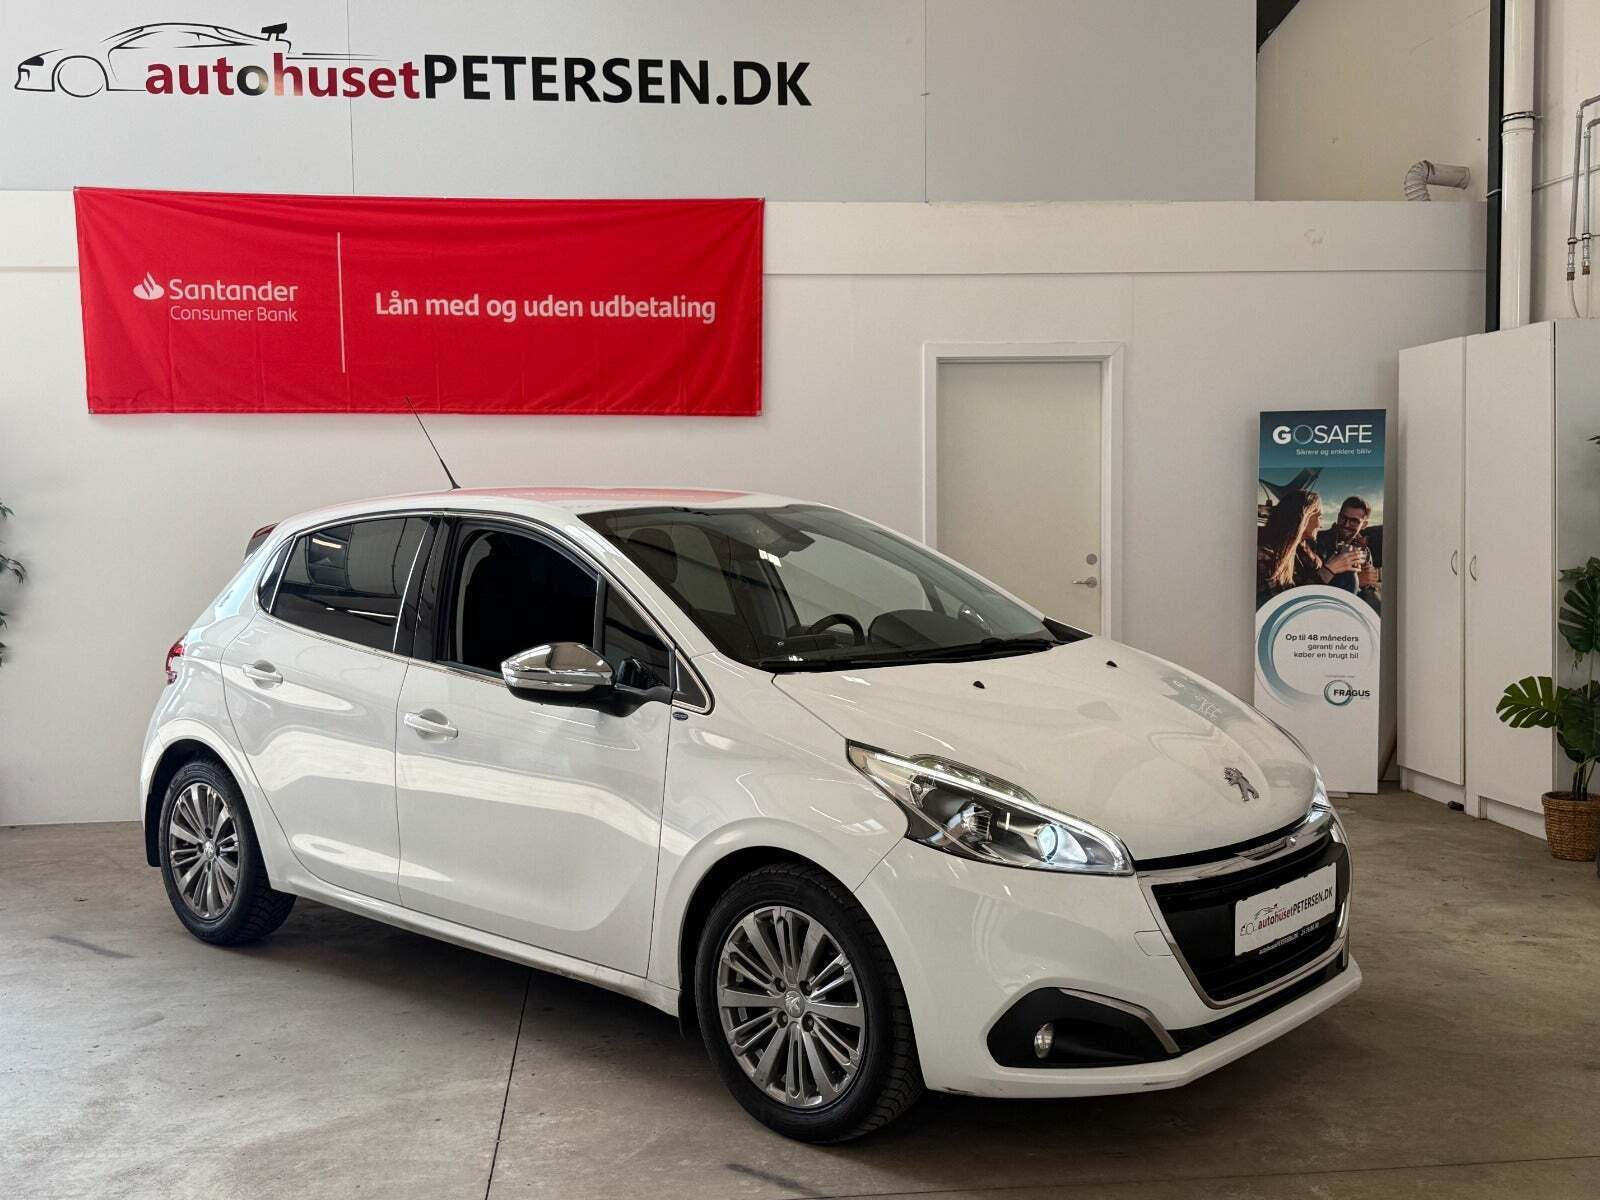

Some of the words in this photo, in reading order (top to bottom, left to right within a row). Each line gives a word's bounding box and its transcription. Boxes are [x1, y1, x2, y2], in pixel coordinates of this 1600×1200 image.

[145, 53, 812, 107] autohusetPETERSEN.DK
[168, 278, 299, 302] Santander
[170, 305, 254, 321] Consumer
[257, 306, 298, 322] Bank
[375, 290, 418, 315] Lån
[426, 294, 479, 316] med
[486, 299, 517, 323] og
[523, 294, 583, 318] uden
[590, 295, 716, 324] udbetaling
[1272, 424, 1373, 445] GOSAFE
[1285, 633, 1298, 642] Op
[1320, 633, 1359, 642] måneders
[1307, 643, 1333, 651] garanti
[1328, 652, 1348, 660] brugt
[1333, 689, 1371, 697] FRAGUS
[1257, 886, 1333, 930] autohusetPETERSEN.DK
